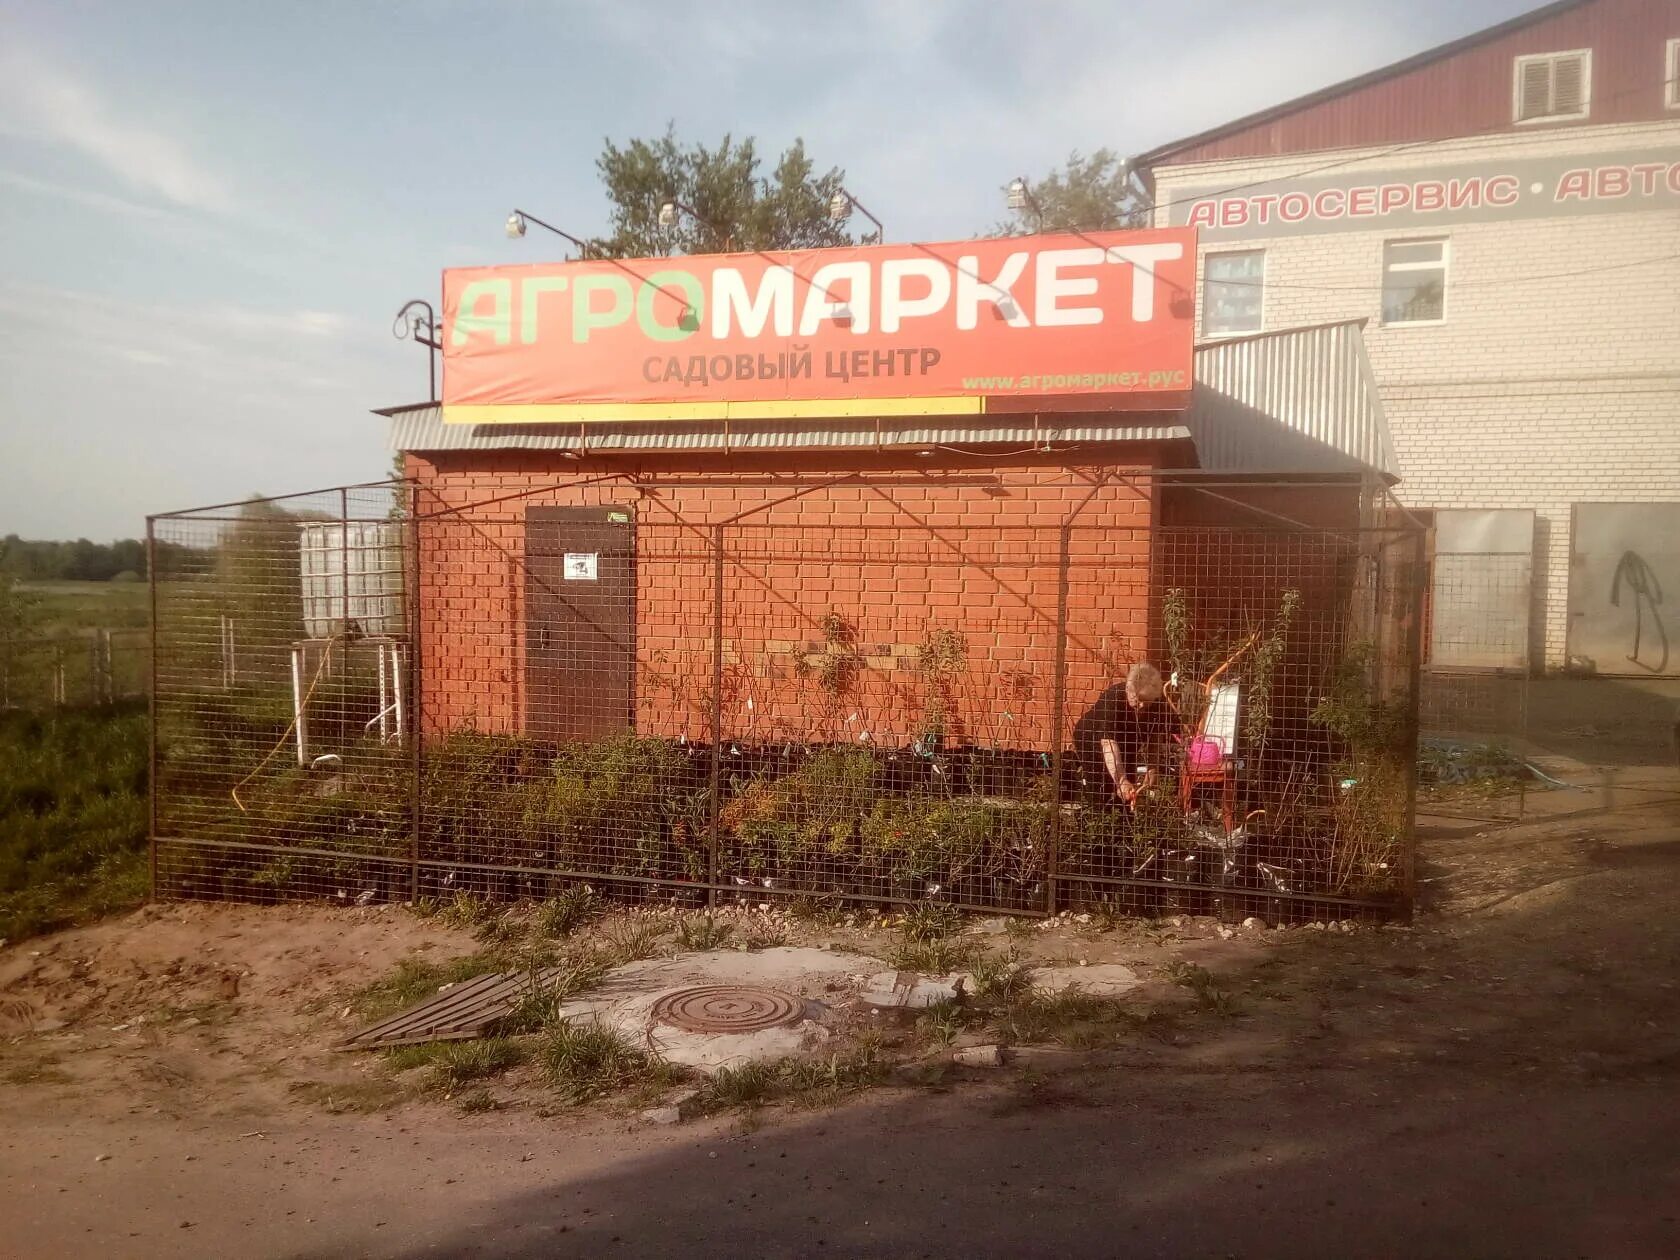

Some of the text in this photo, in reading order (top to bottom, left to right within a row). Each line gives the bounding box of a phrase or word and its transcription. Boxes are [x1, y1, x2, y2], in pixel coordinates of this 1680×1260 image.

[1186, 175, 1519, 229] АВТОСЕРВИС
[452, 242, 1183, 346] АГРОМАРКЕТ
[642, 344, 941, 386] САДОВЫЙ ЦЕНТР
[962, 370, 1185, 389] www.агромаркет.рус
